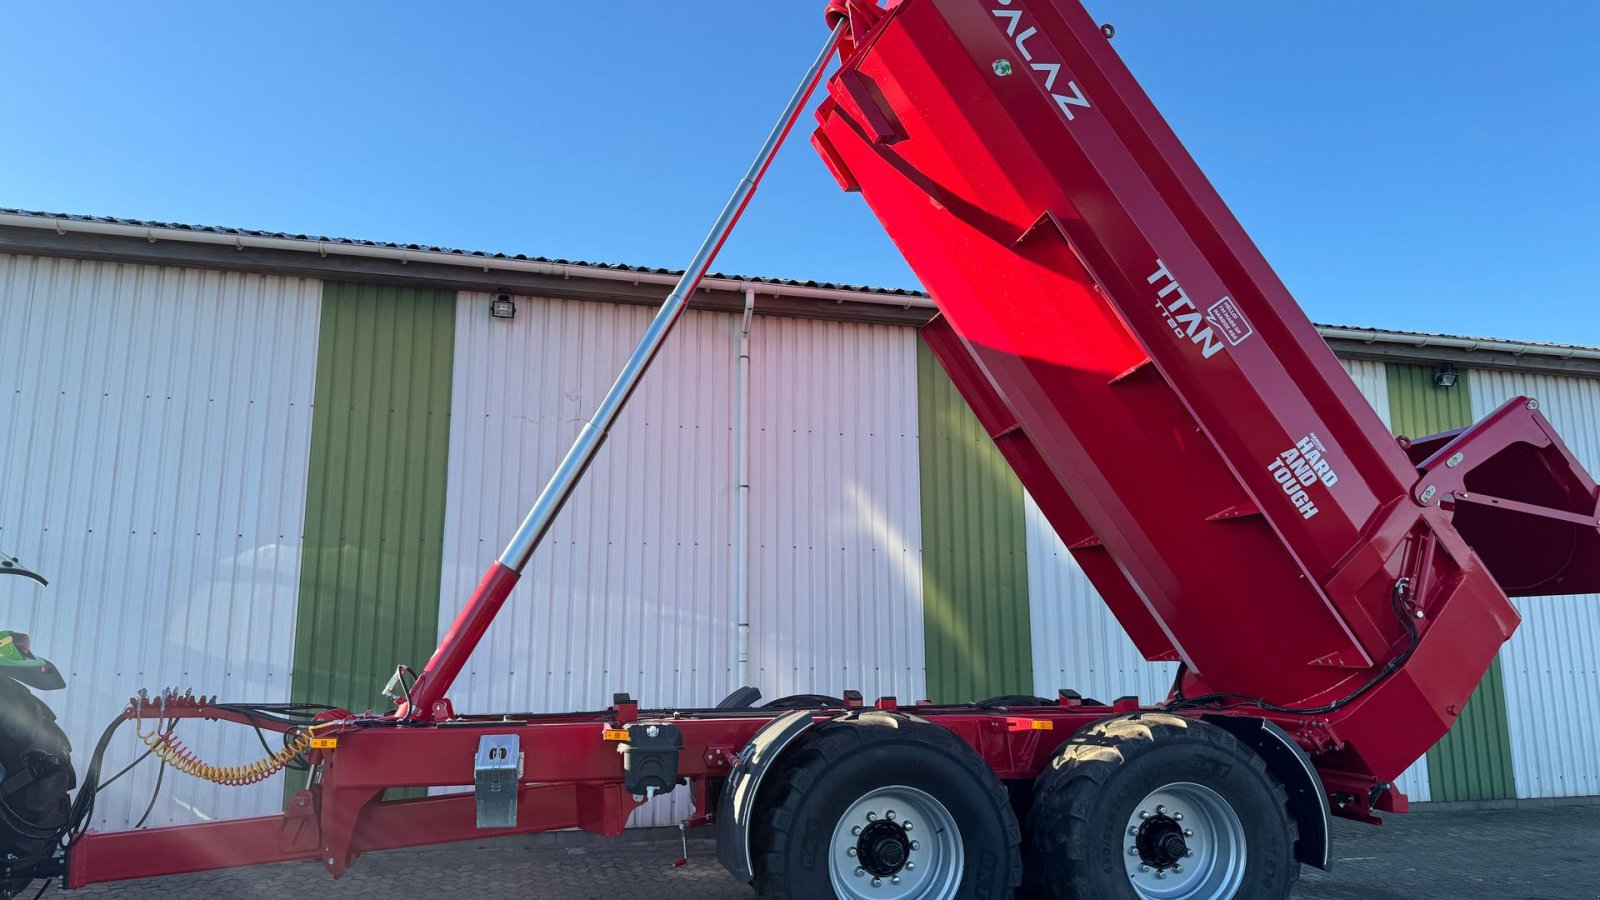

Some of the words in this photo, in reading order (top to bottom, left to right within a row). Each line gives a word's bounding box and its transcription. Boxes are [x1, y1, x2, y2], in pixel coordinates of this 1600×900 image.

[992, 0, 1091, 121] ALAZ
[1146, 258, 1225, 359] TITAN
[1155, 298, 1185, 339] TT20
[1213, 308, 1231, 330] HARDOX
[1223, 312, 1237, 328] MADE
[1233, 326, 1242, 335] OF
[1280, 447, 1318, 487] AND
[1296, 436, 1338, 488] HARD
[1267, 456, 1319, 520] TOUGH
